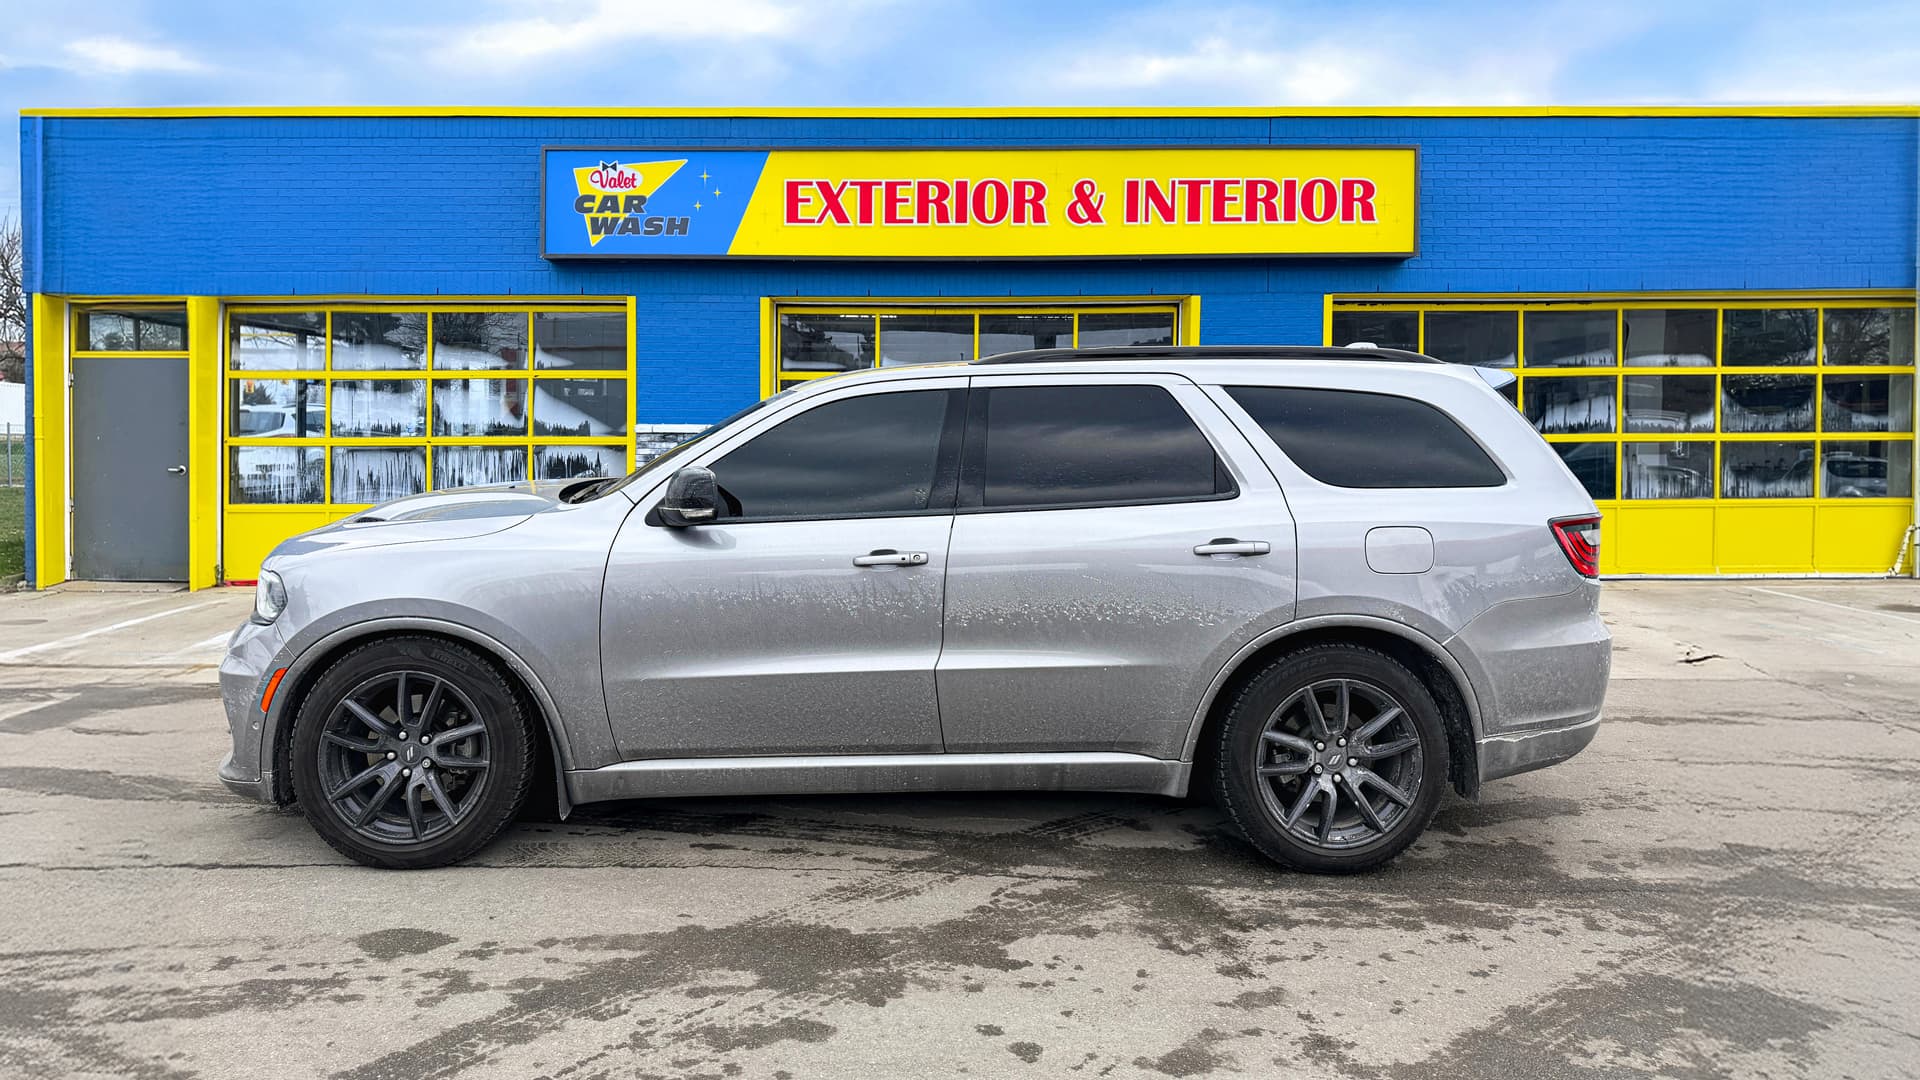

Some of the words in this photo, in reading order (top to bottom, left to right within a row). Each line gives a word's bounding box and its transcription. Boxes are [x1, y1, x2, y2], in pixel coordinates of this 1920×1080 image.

[589, 170, 637, 189] Valet
[574, 194, 647, 214] CAR
[786, 179, 1047, 224] EXTERIOR
[1067, 180, 1104, 224] &
[1125, 179, 1375, 223] INTERIOR
[589, 216, 690, 236] WASH
